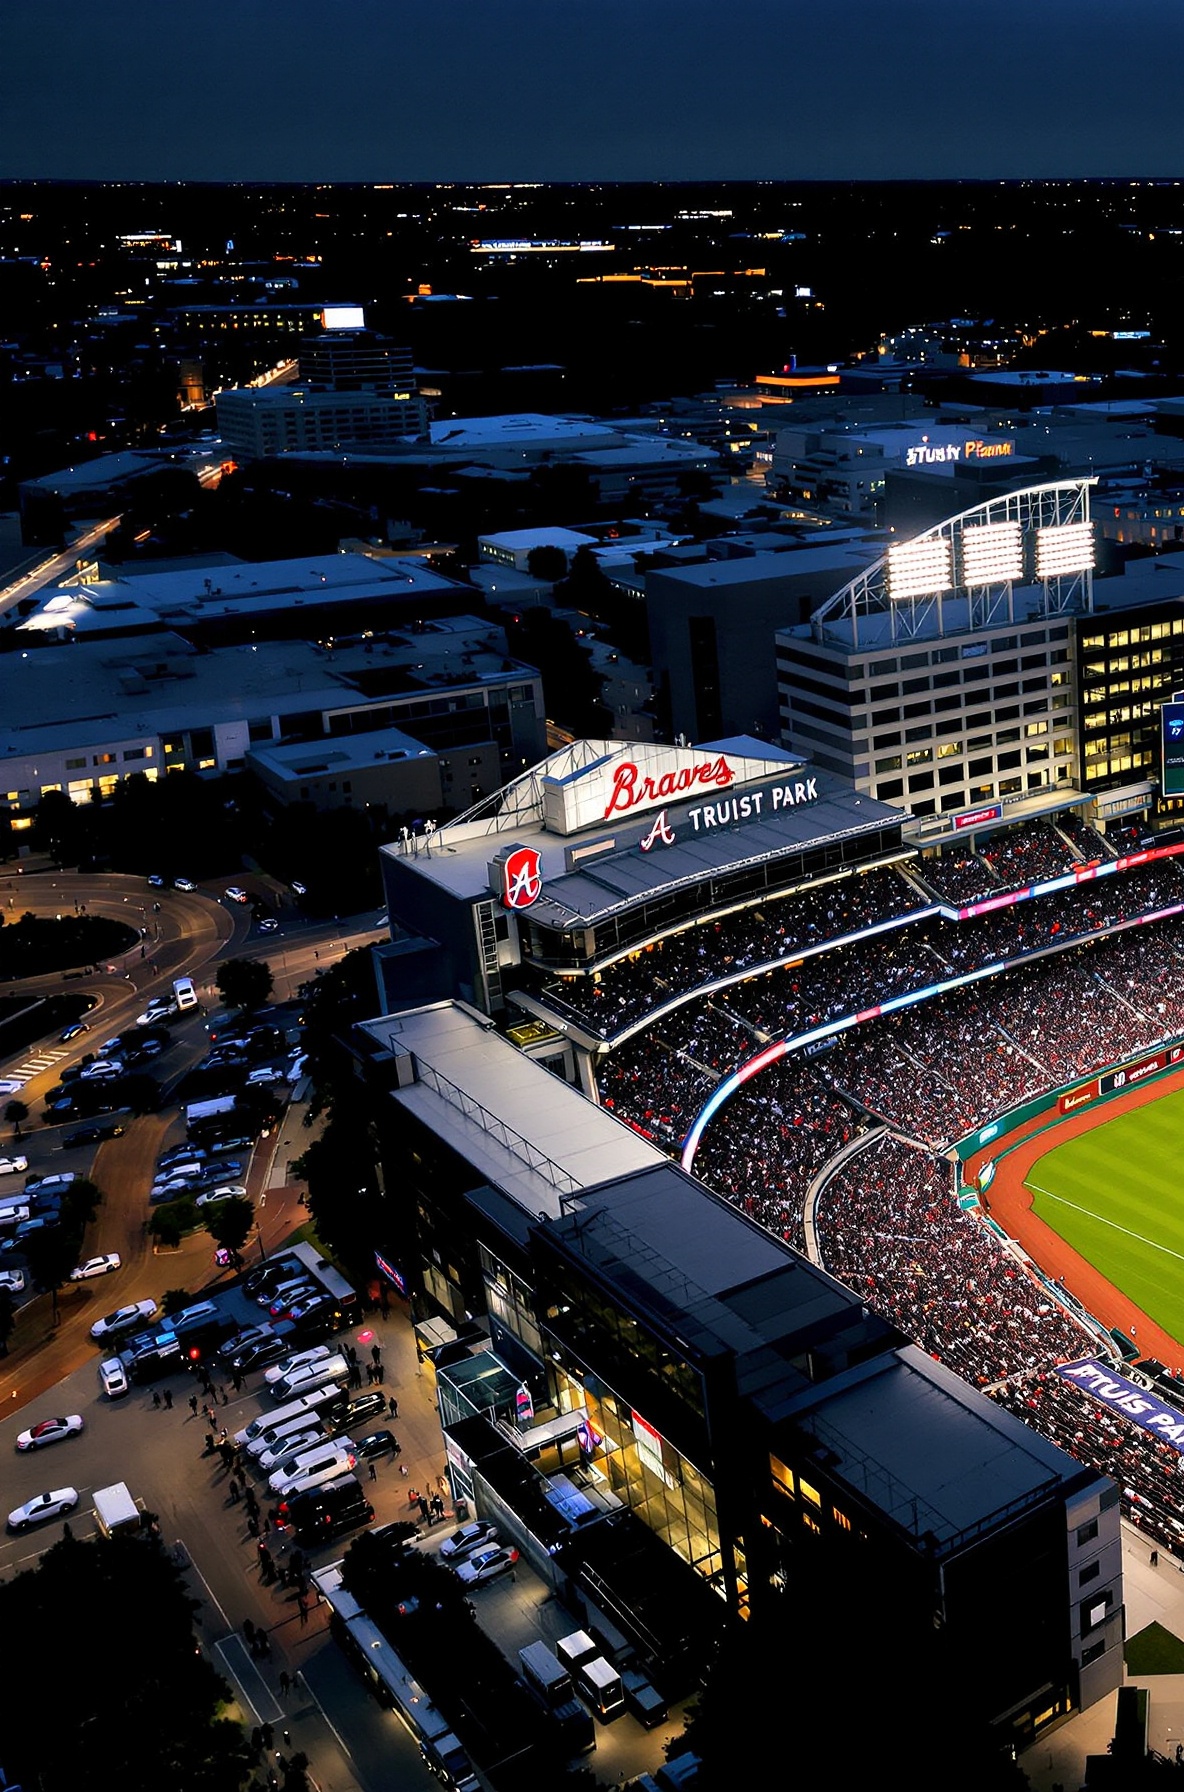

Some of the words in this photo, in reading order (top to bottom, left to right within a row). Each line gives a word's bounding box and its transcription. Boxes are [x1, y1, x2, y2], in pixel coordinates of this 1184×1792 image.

[604, 755, 736, 821] Braves
[689, 791, 764, 832] TRUIST
[771, 777, 819, 811] PARK
